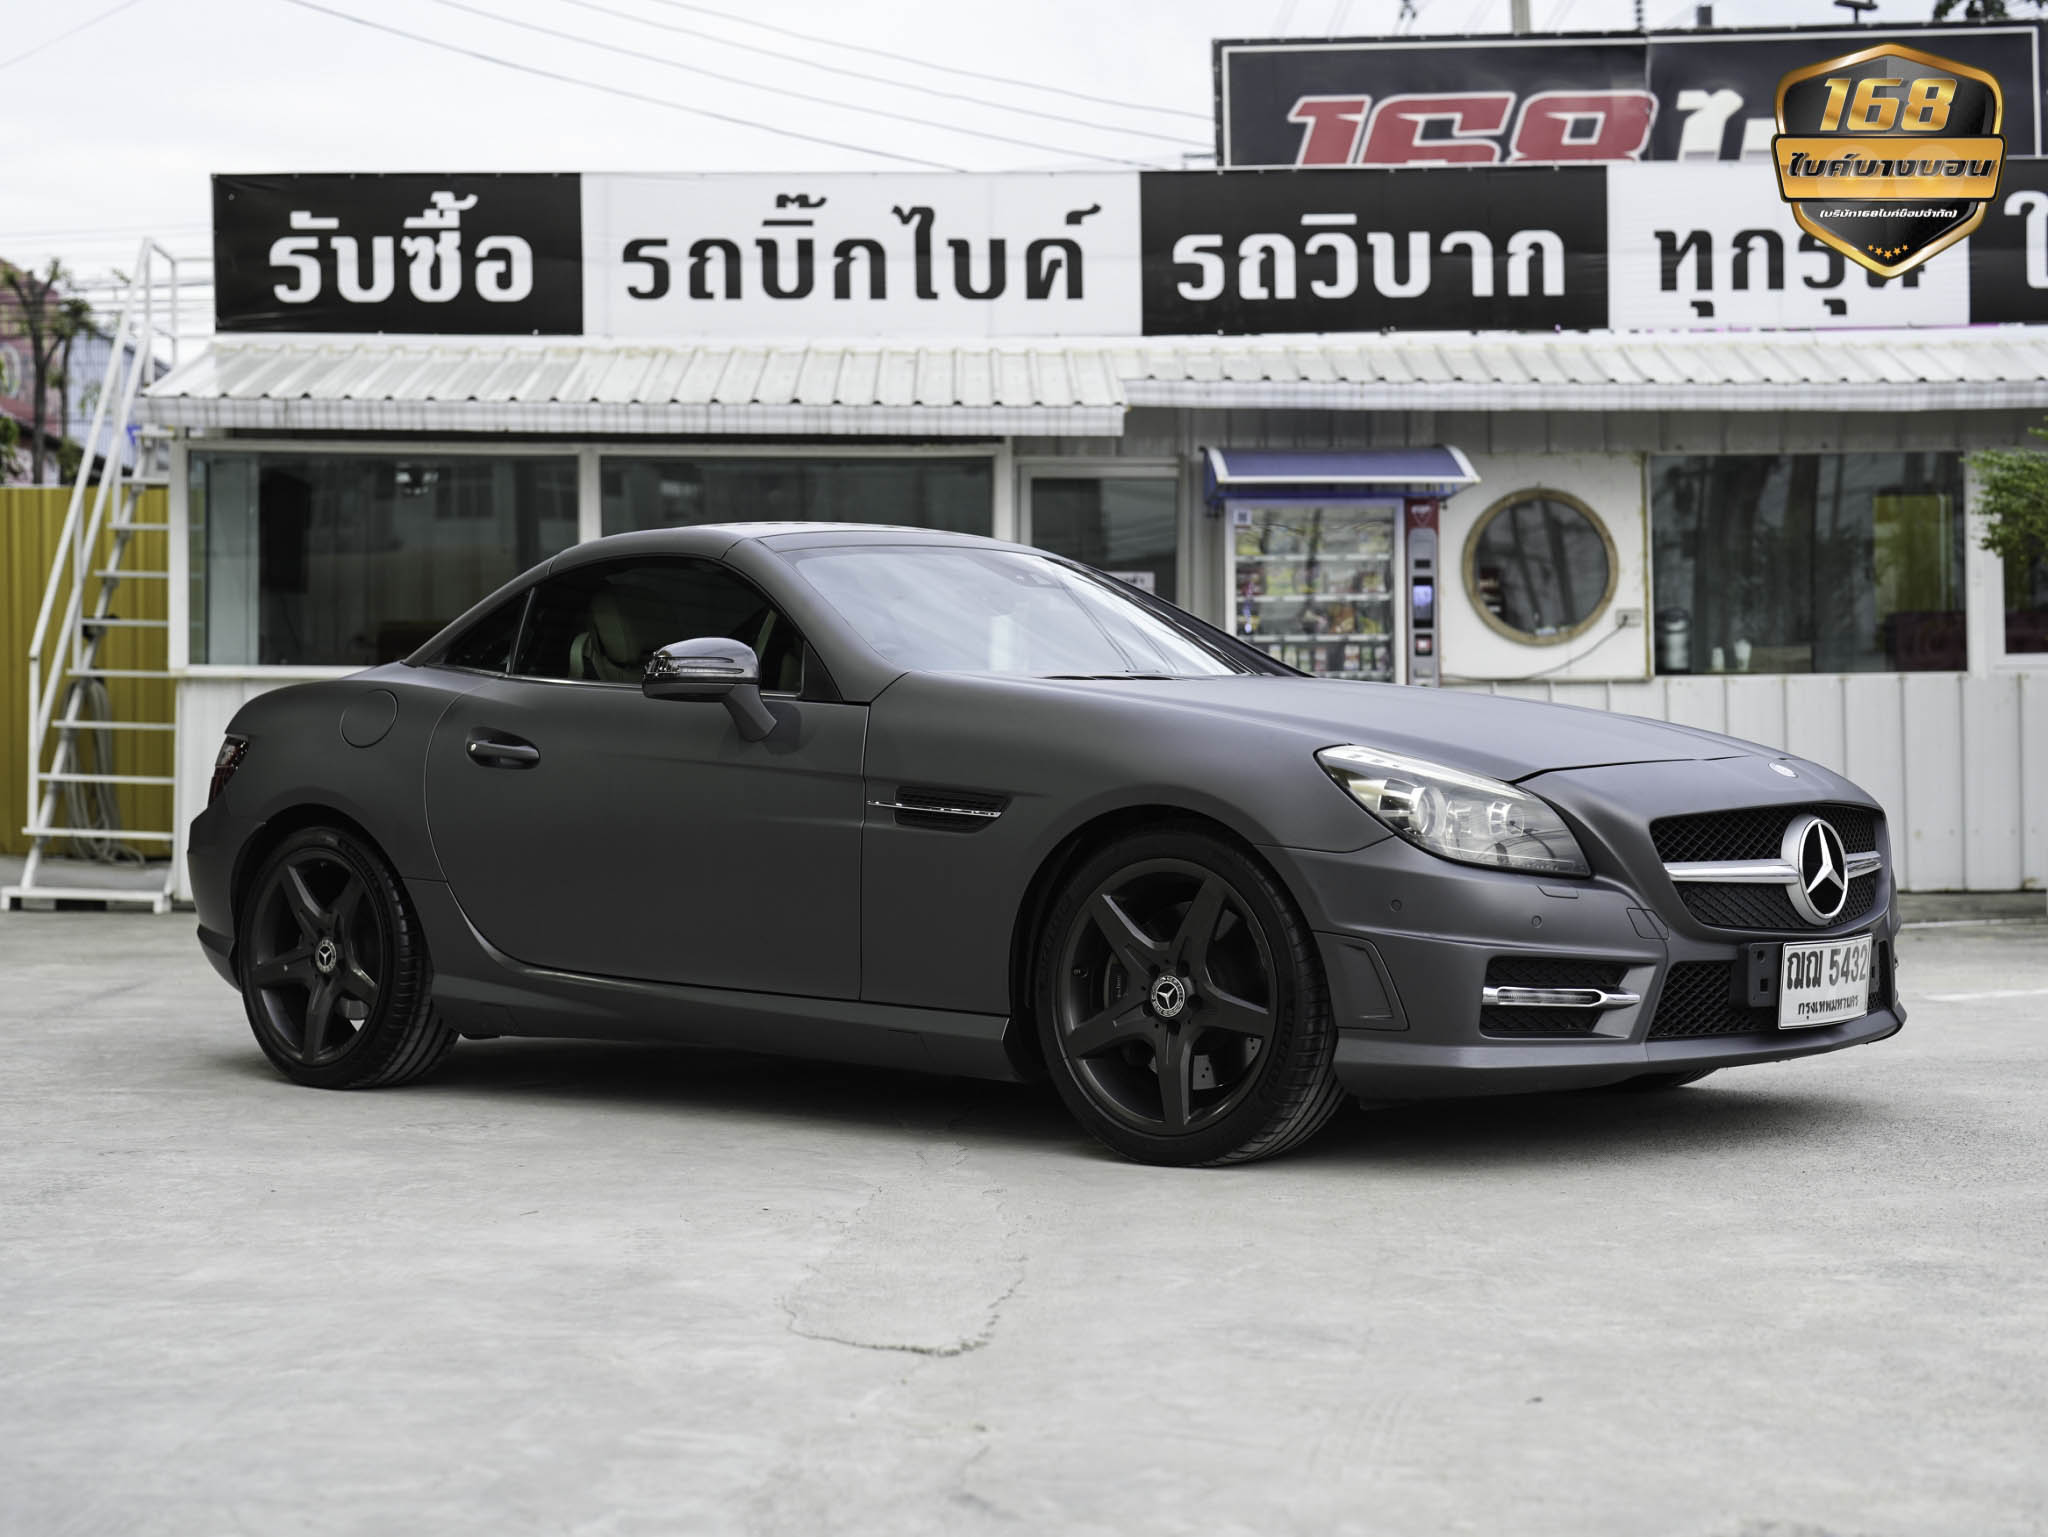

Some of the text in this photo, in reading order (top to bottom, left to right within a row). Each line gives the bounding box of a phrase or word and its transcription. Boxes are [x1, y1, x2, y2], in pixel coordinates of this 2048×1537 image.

[269, 191, 534, 303] รับซื้อ
[622, 193, 1101, 300] รถบิ๊กไบค์
[1172, 213, 1566, 300] รถวิบาก
[1829, 944, 1867, 986] 5432
[1798, 995, 1859, 1020] กรุงเทพมหานคร
